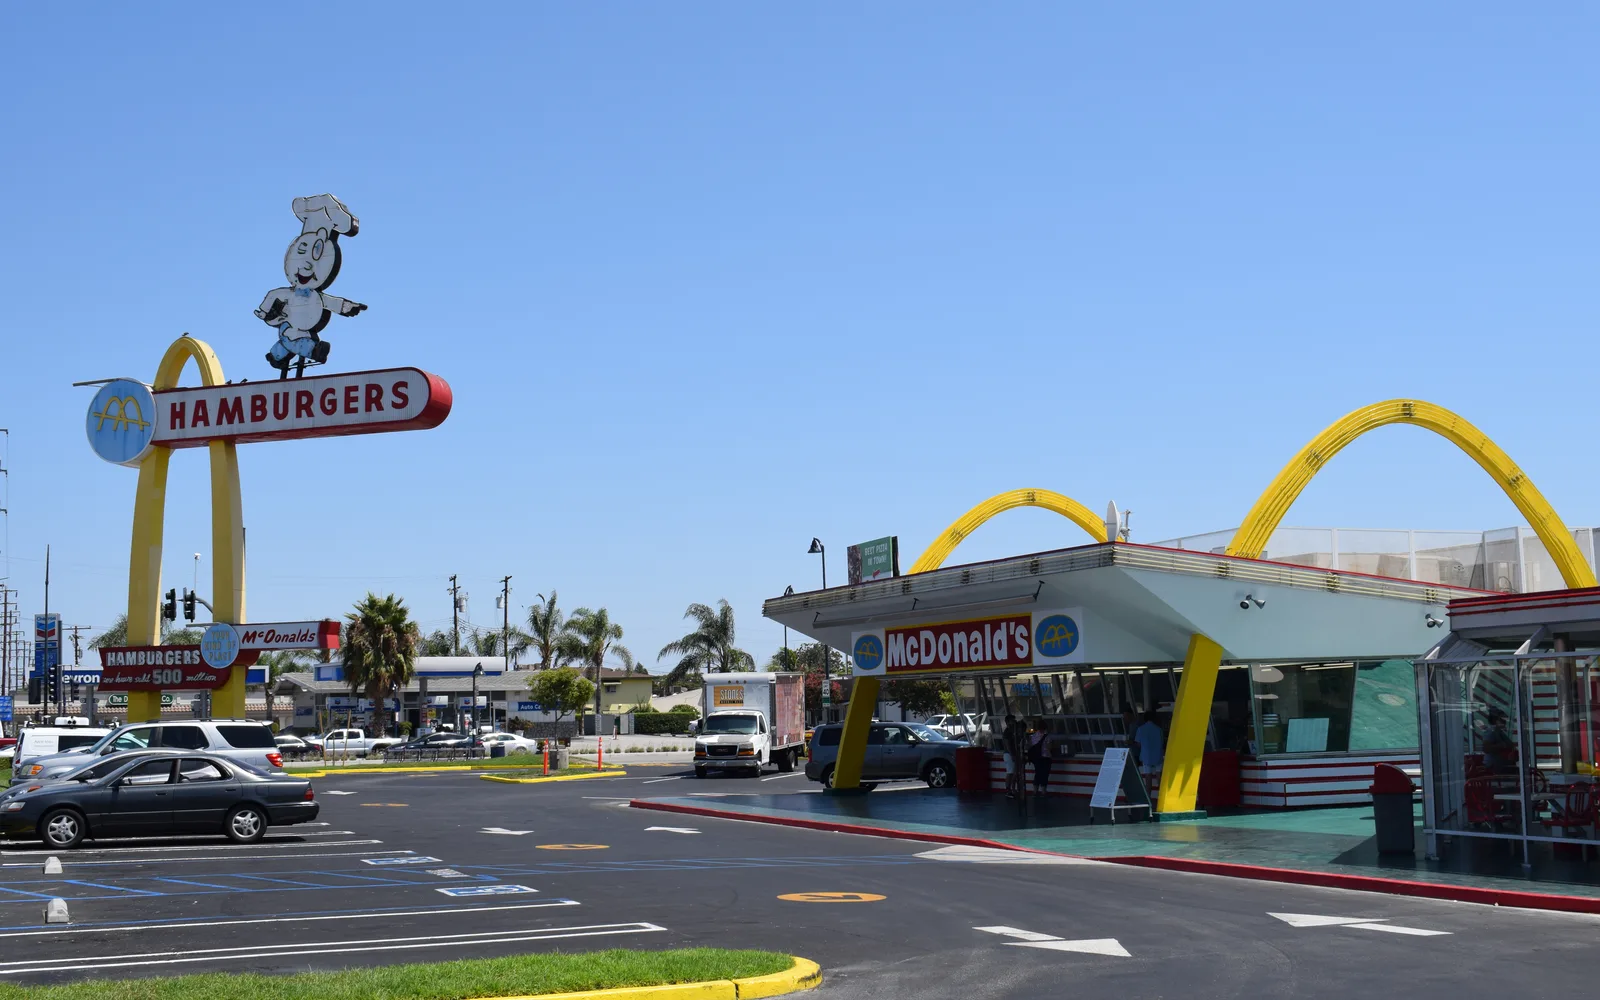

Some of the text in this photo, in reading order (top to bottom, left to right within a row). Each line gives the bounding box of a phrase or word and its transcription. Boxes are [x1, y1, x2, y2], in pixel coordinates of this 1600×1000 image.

[170, 381, 409, 430] HAMBURGERS
[211, 631, 230, 640] YOUR
[241, 628, 316, 645] McDonalds
[204, 641, 236, 650] KIND OF
[887, 621, 1029, 668] McDonald's
[106, 649, 200, 667] HAMBURGERS
[209, 651, 232, 661] PLACE
[134, 673, 151, 683] sold
[152, 669, 182, 684] 500
[186, 671, 217, 682] million
